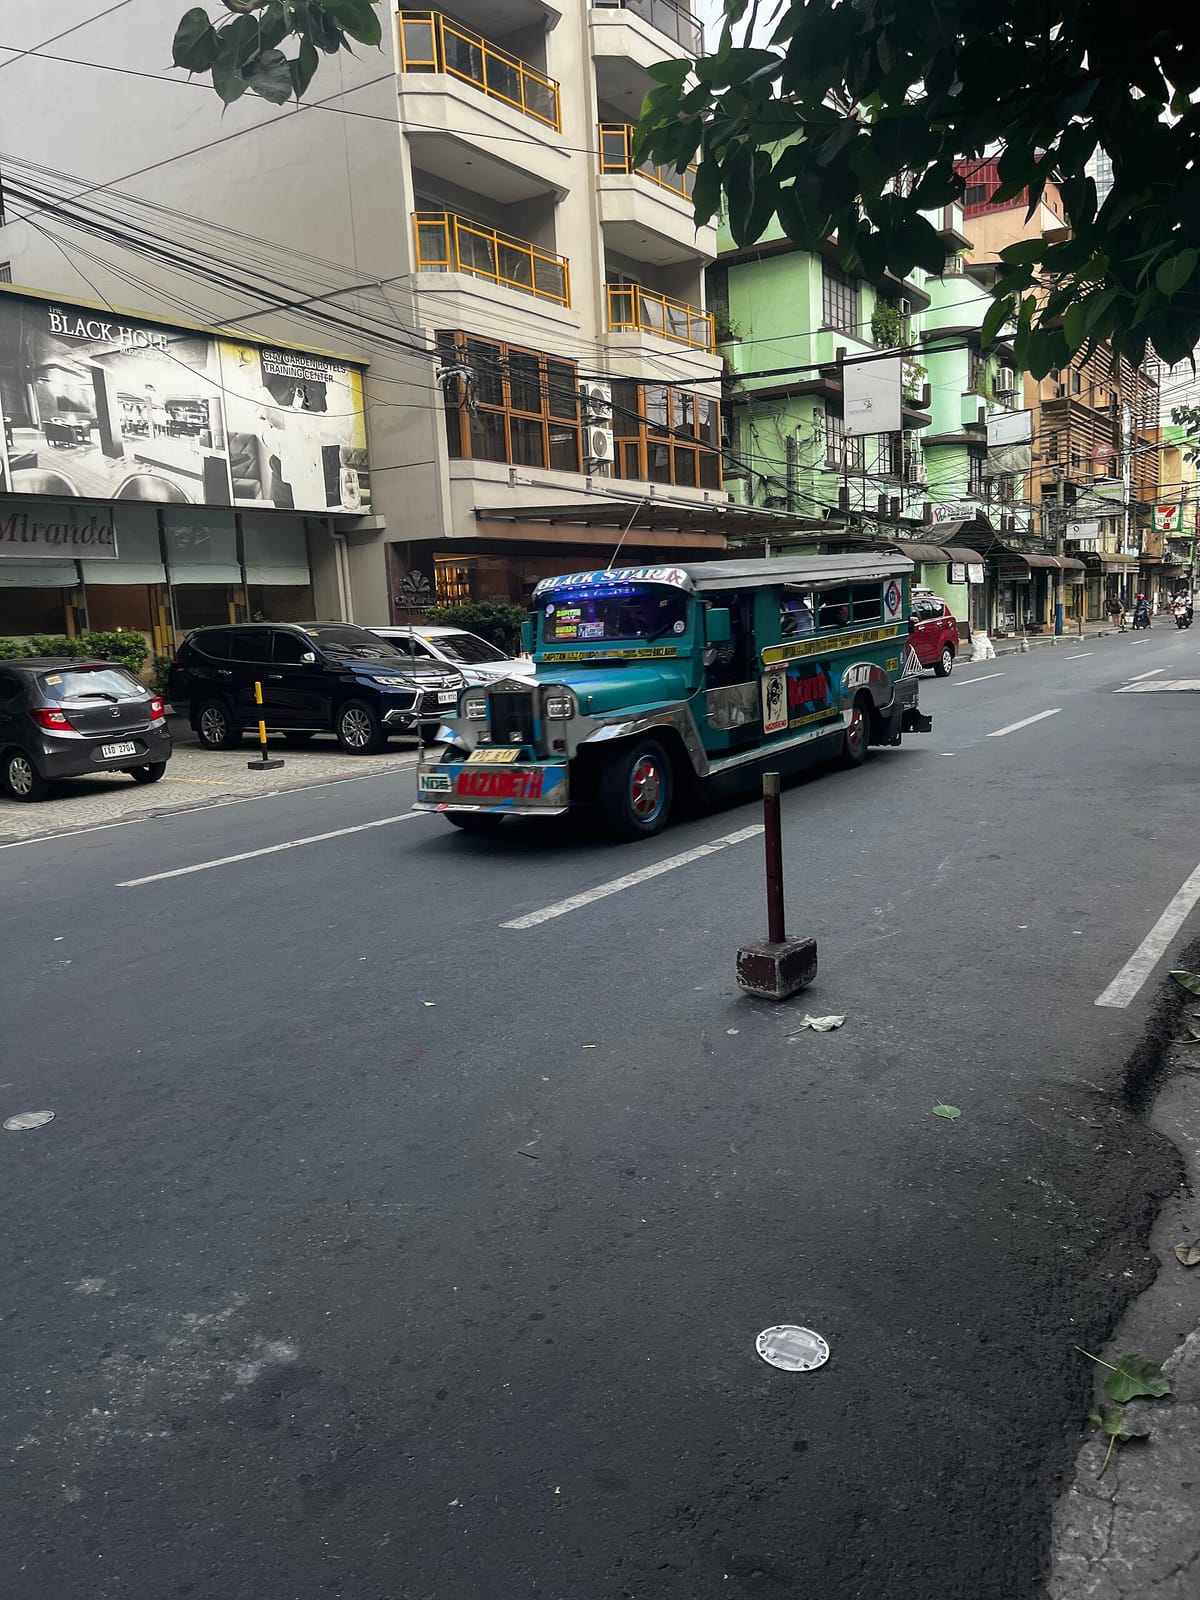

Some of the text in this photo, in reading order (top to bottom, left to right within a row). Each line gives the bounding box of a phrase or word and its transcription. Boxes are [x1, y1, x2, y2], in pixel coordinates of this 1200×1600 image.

[48, 312, 169, 352] BLACK HOLE
[263, 361, 334, 384] TRAINING CENTER
[283, 354, 317, 370] GARDEN
[538, 568, 665, 590] BLACK STAR
[457, 773, 544, 798] NAZARETH
